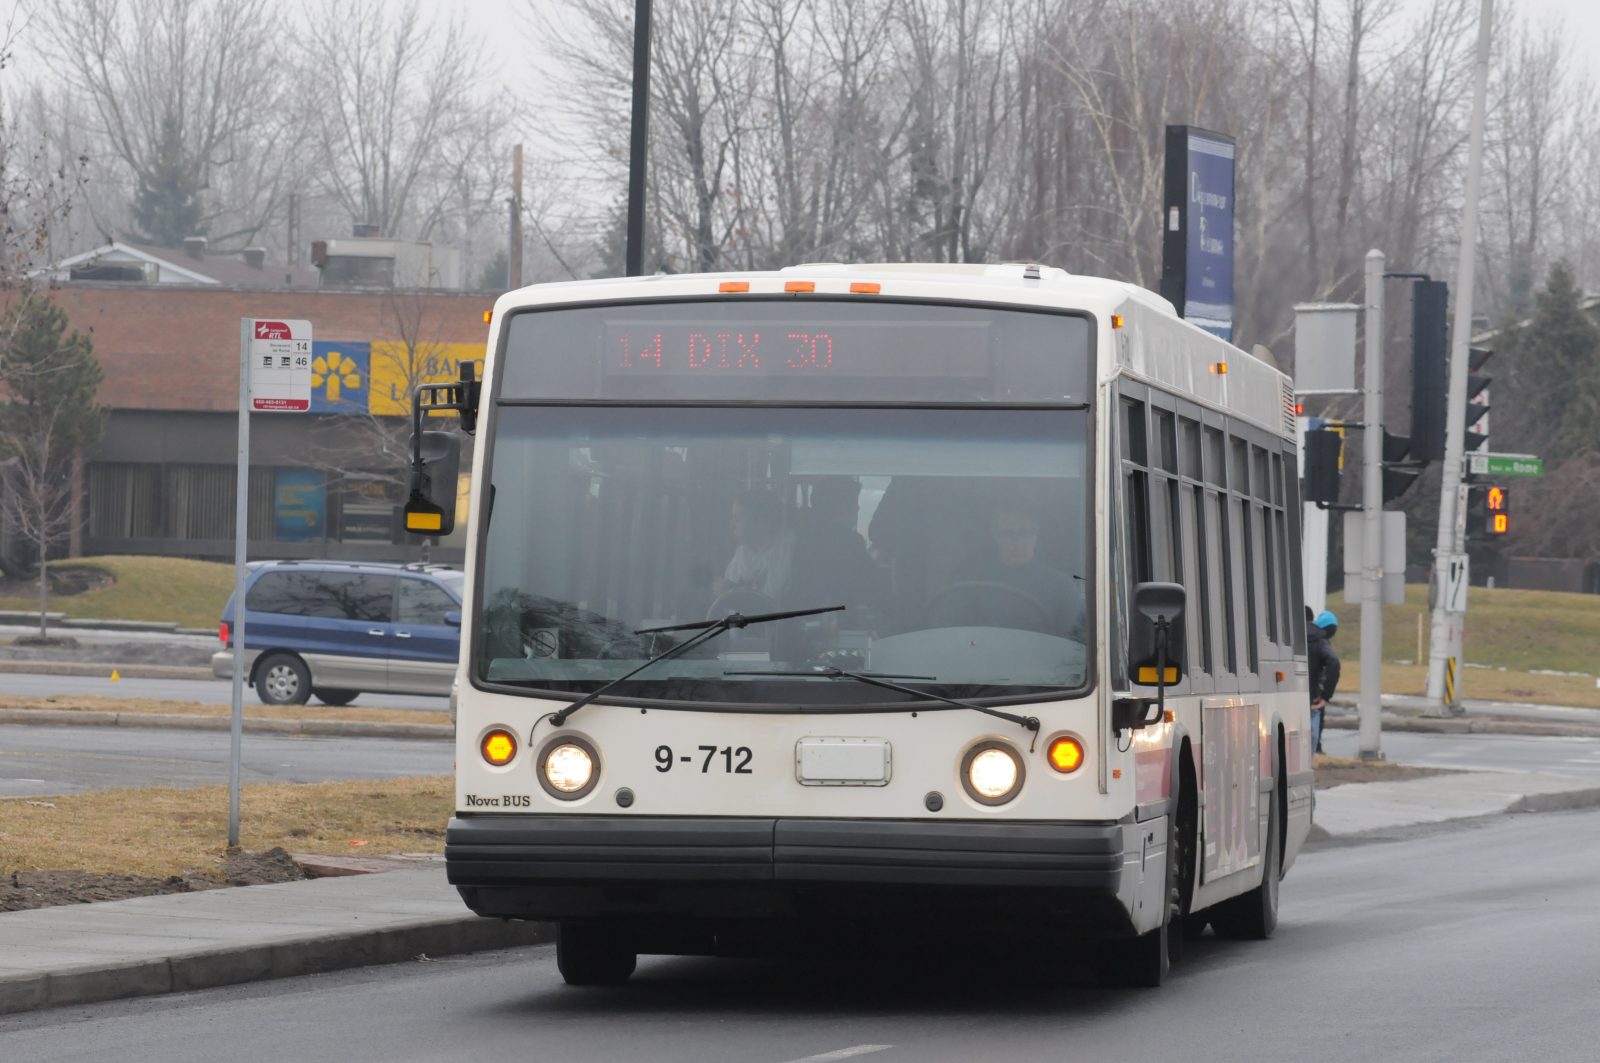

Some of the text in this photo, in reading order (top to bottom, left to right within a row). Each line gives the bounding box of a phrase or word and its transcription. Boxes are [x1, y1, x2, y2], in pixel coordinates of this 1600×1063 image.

[296, 342, 308, 351] 14
[617, 333, 833, 369] 14 DIX 30
[295, 357, 308, 366] 46
[654, 744, 754, 775] 9-712
[465, 793, 531, 807] Nova BUS
